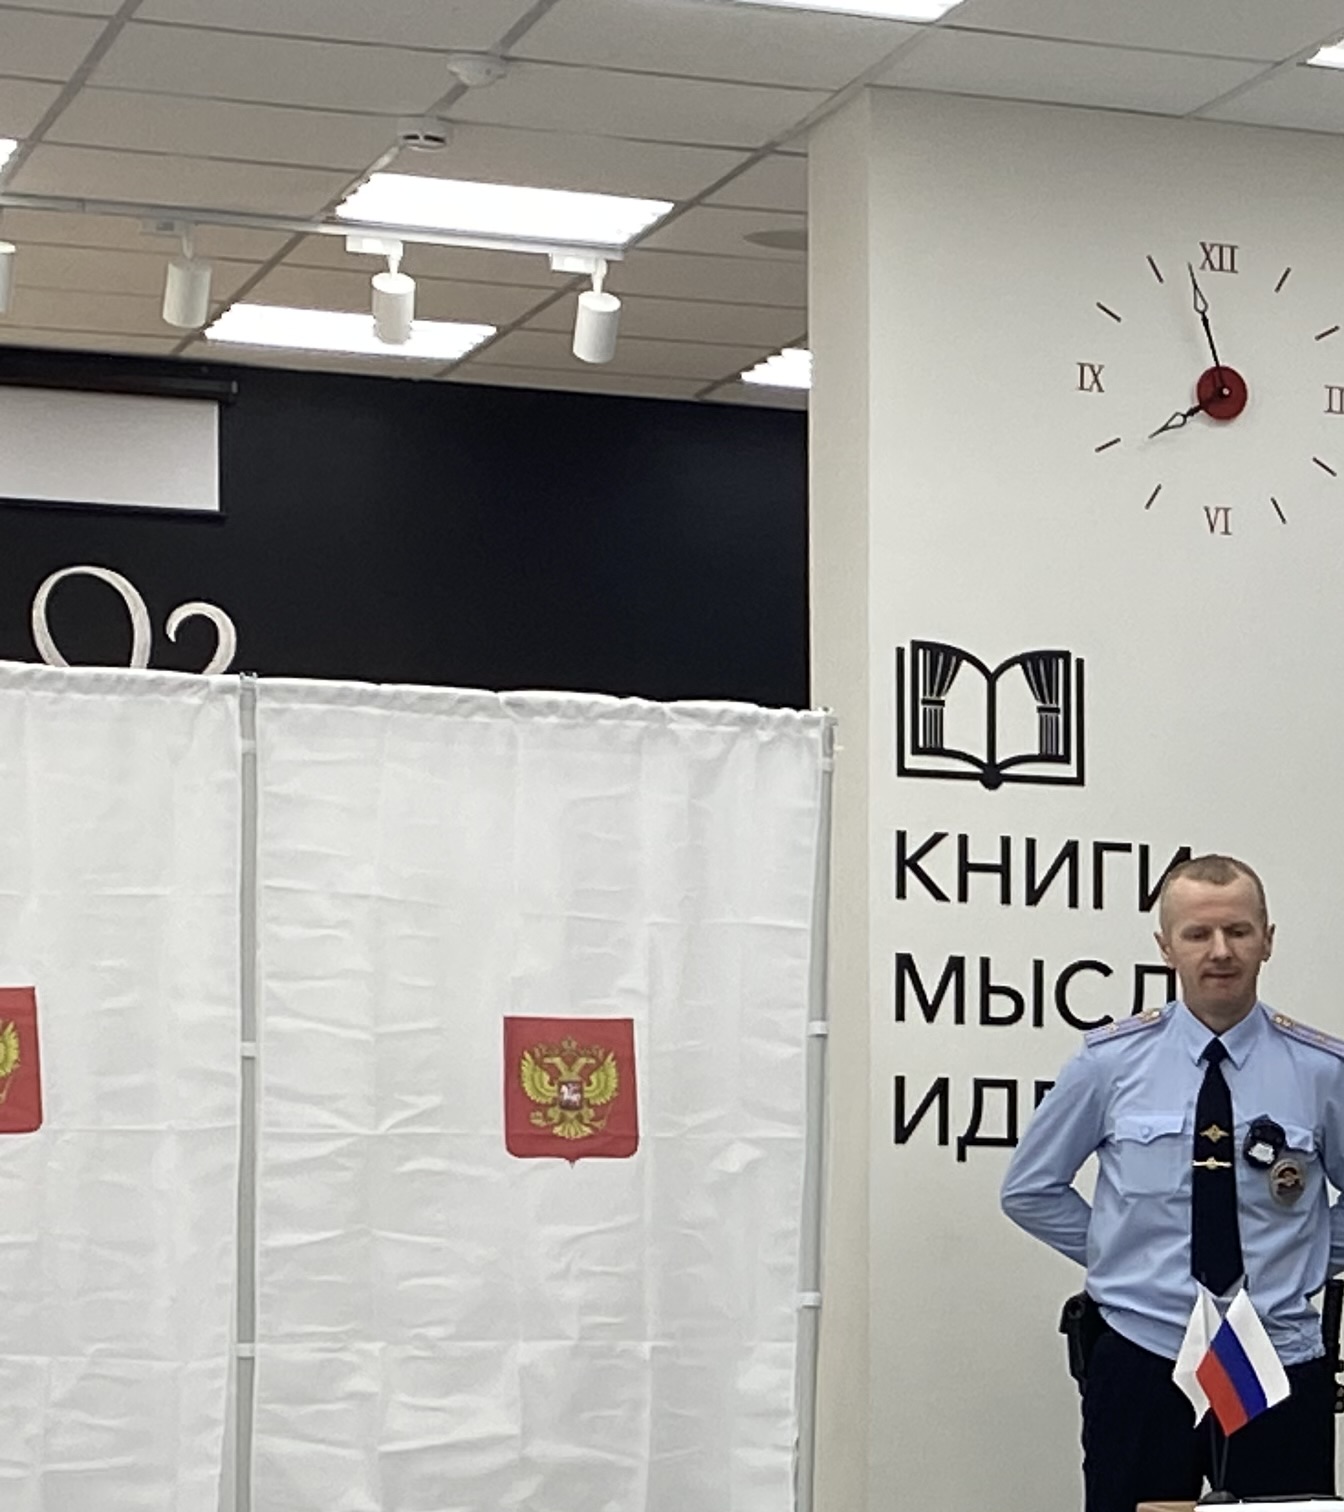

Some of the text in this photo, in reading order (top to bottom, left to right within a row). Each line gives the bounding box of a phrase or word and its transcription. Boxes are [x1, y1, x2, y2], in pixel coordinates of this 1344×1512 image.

[1199, 241, 1239, 274] XII
[1076, 362, 1105, 393] IX
[1203, 505, 1233, 536] VI
[895, 829, 1192, 913] КНИГИ
[895, 952, 1177, 1031] МЫСЛ
[894, 1075, 1056, 1162] ИД
